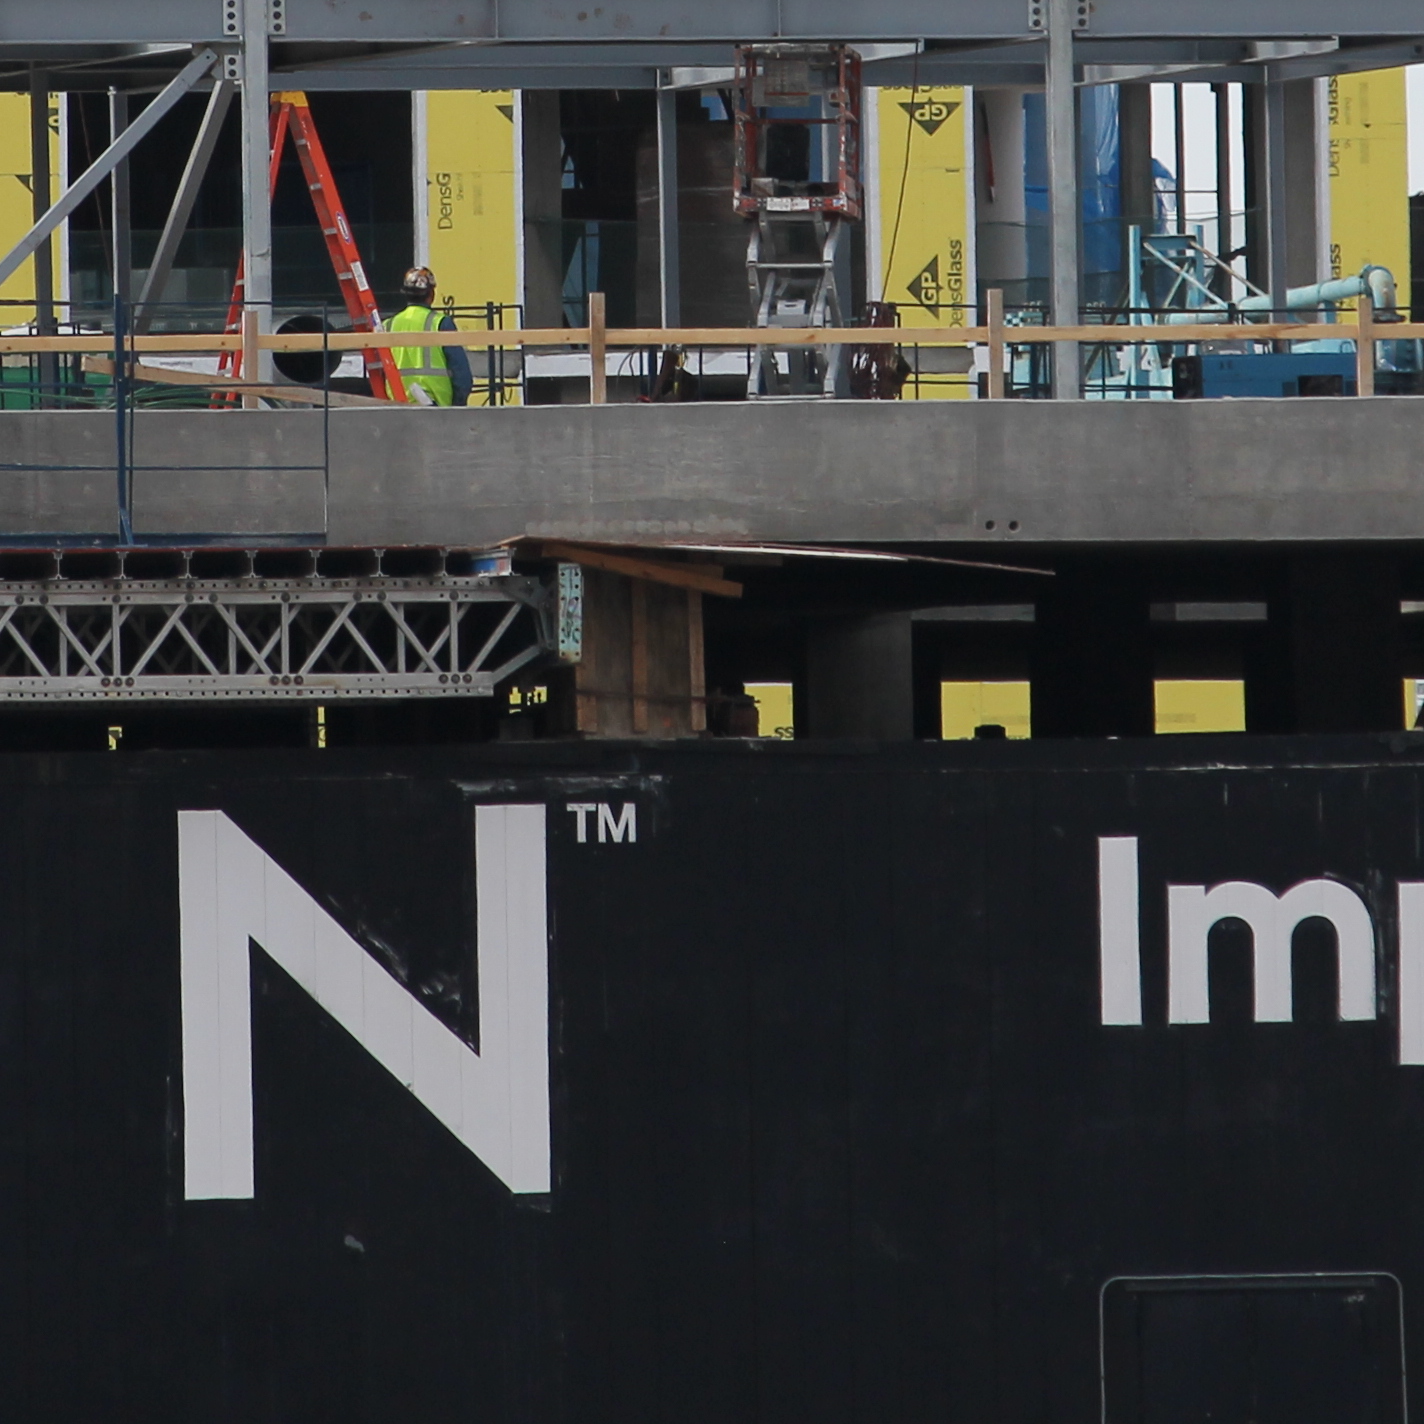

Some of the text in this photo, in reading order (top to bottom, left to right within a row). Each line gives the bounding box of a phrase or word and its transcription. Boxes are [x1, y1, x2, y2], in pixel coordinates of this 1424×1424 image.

[914, 103, 949, 122] GP
[436, 171, 454, 231] DensG
[921, 269, 941, 304] GP
[567, 804, 637, 844] TM
